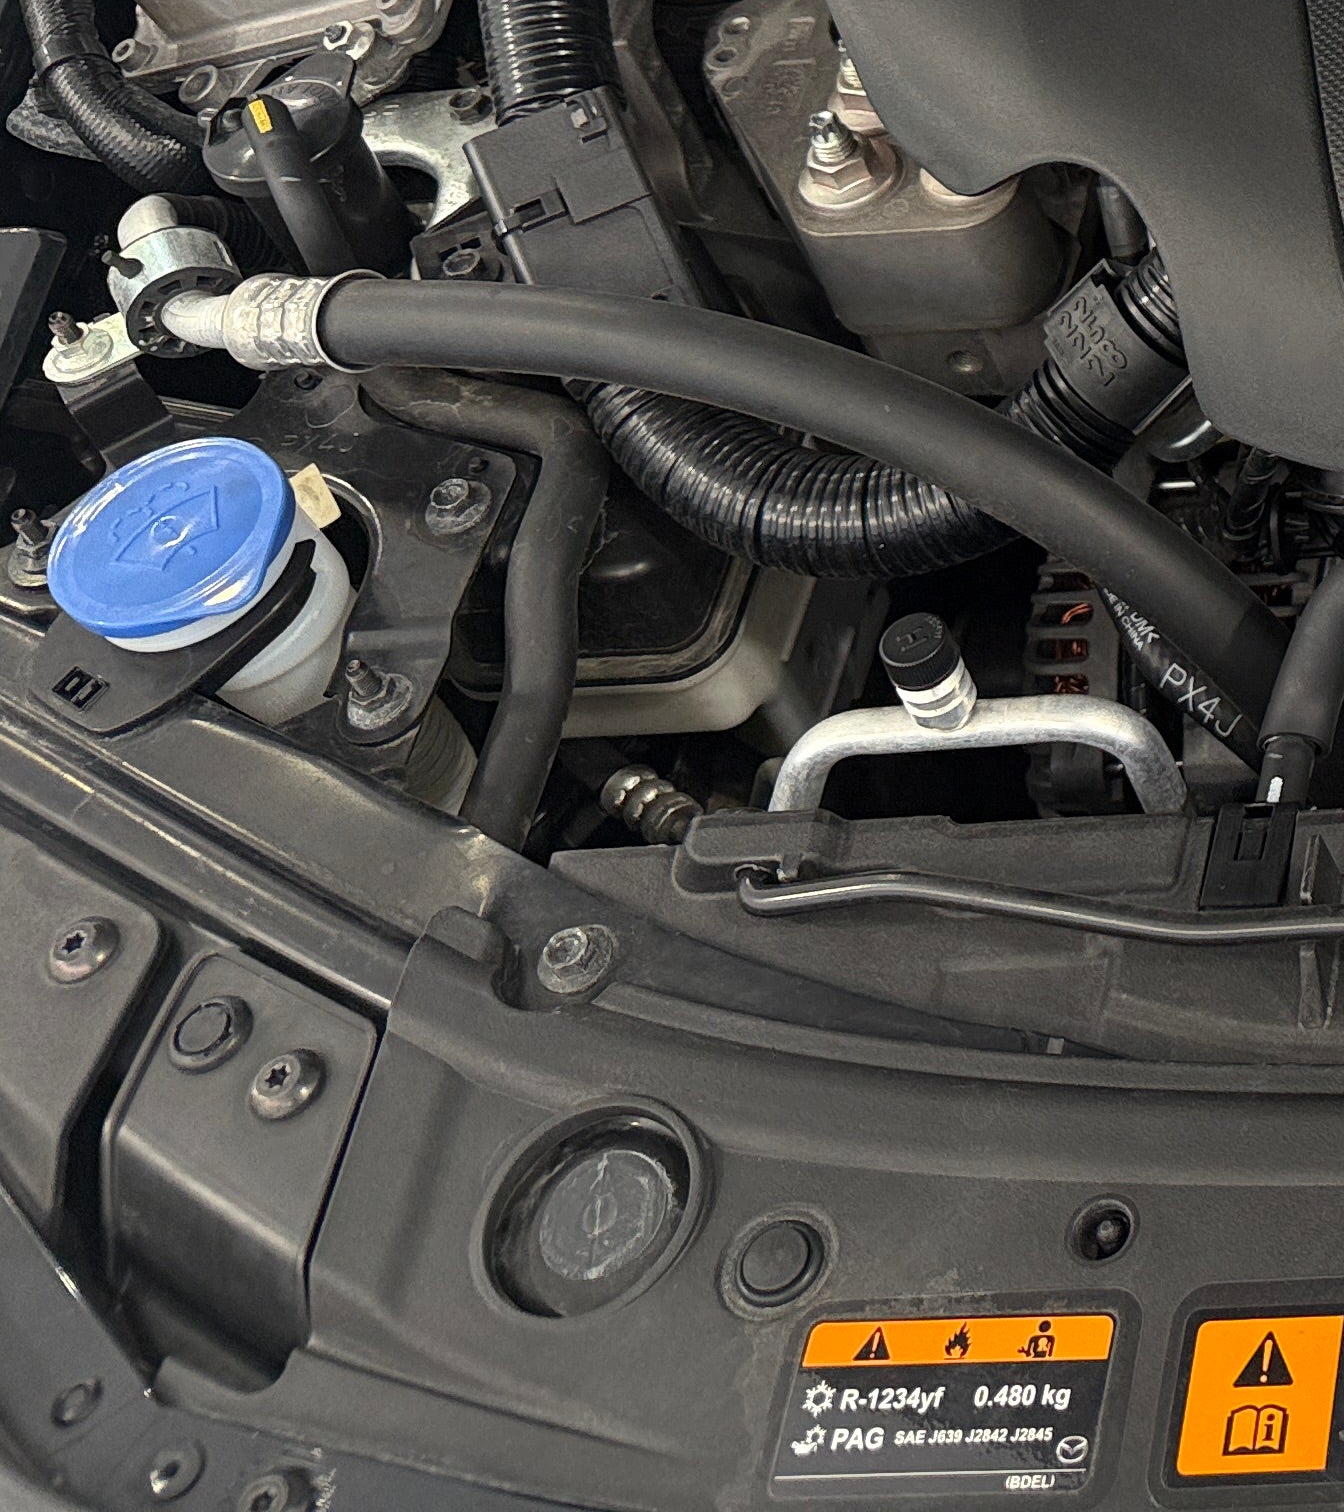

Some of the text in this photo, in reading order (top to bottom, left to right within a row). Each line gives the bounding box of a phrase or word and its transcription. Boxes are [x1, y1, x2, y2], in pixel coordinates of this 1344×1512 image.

[1159, 663, 1243, 738] PX4J
[840, 1384, 1071, 1413] R-1234yf 0.480 kg
[831, 1427, 1053, 1451] PAG SAE J639 J2842 J2845
[1005, 1473, 1055, 1490] (BDEL)
